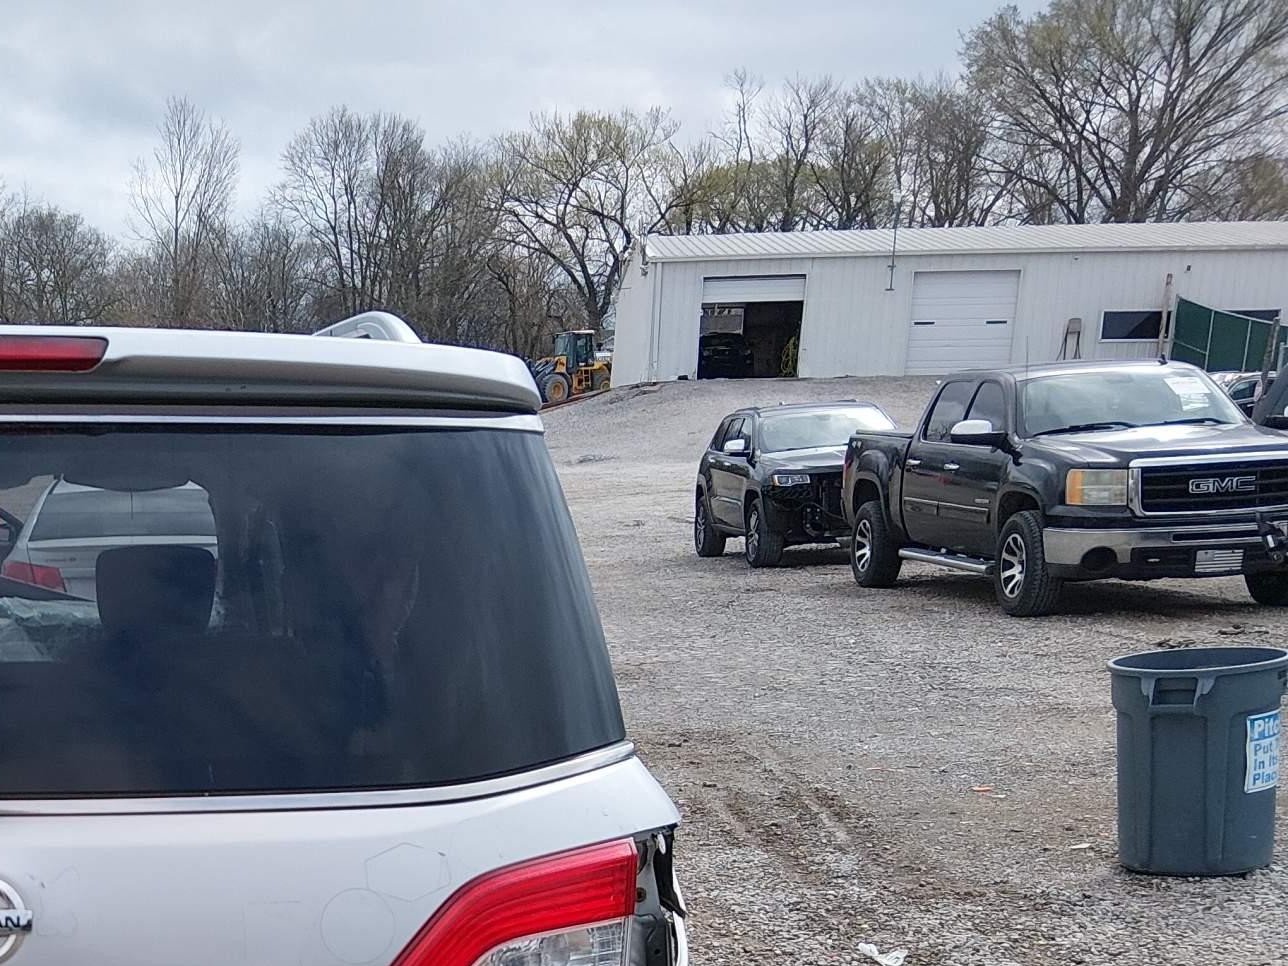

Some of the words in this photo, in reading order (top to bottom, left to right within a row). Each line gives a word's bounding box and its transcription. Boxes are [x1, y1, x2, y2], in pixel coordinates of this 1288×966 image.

[1188, 476, 1257, 494] GMC
[1254, 742, 1273, 756] Put
[1254, 758, 1265, 771] In
